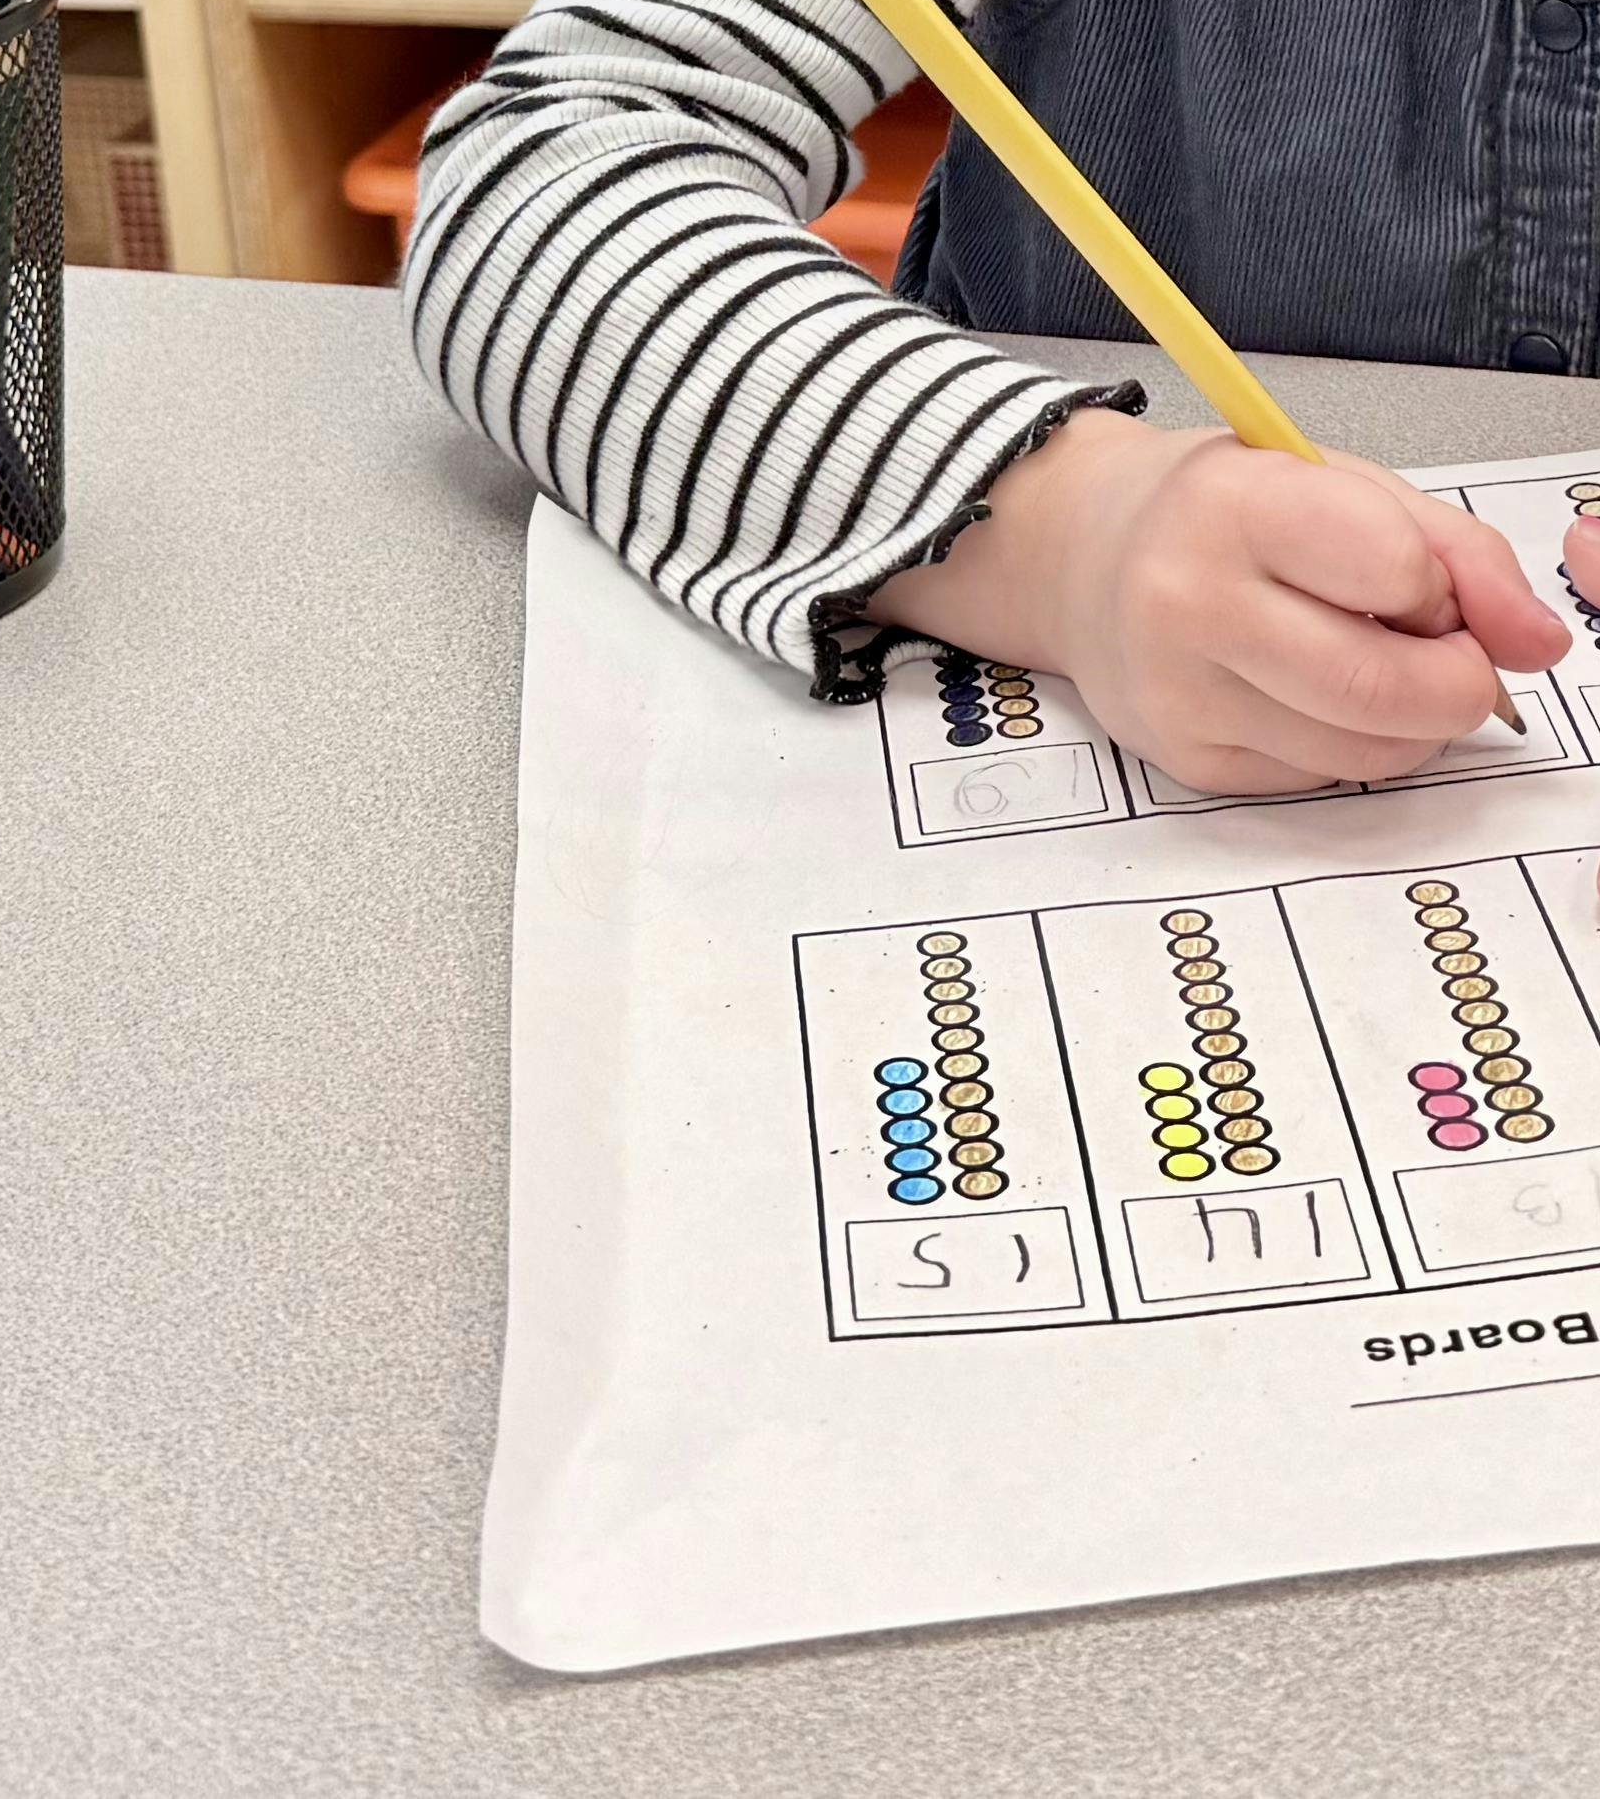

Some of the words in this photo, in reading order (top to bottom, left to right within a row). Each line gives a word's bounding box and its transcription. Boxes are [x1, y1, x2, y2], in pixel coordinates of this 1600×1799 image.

[1193, 1190, 1322, 1263] 14
[897, 1232, 1030, 1288] 15
[1363, 1310, 1600, 1366] Boards
